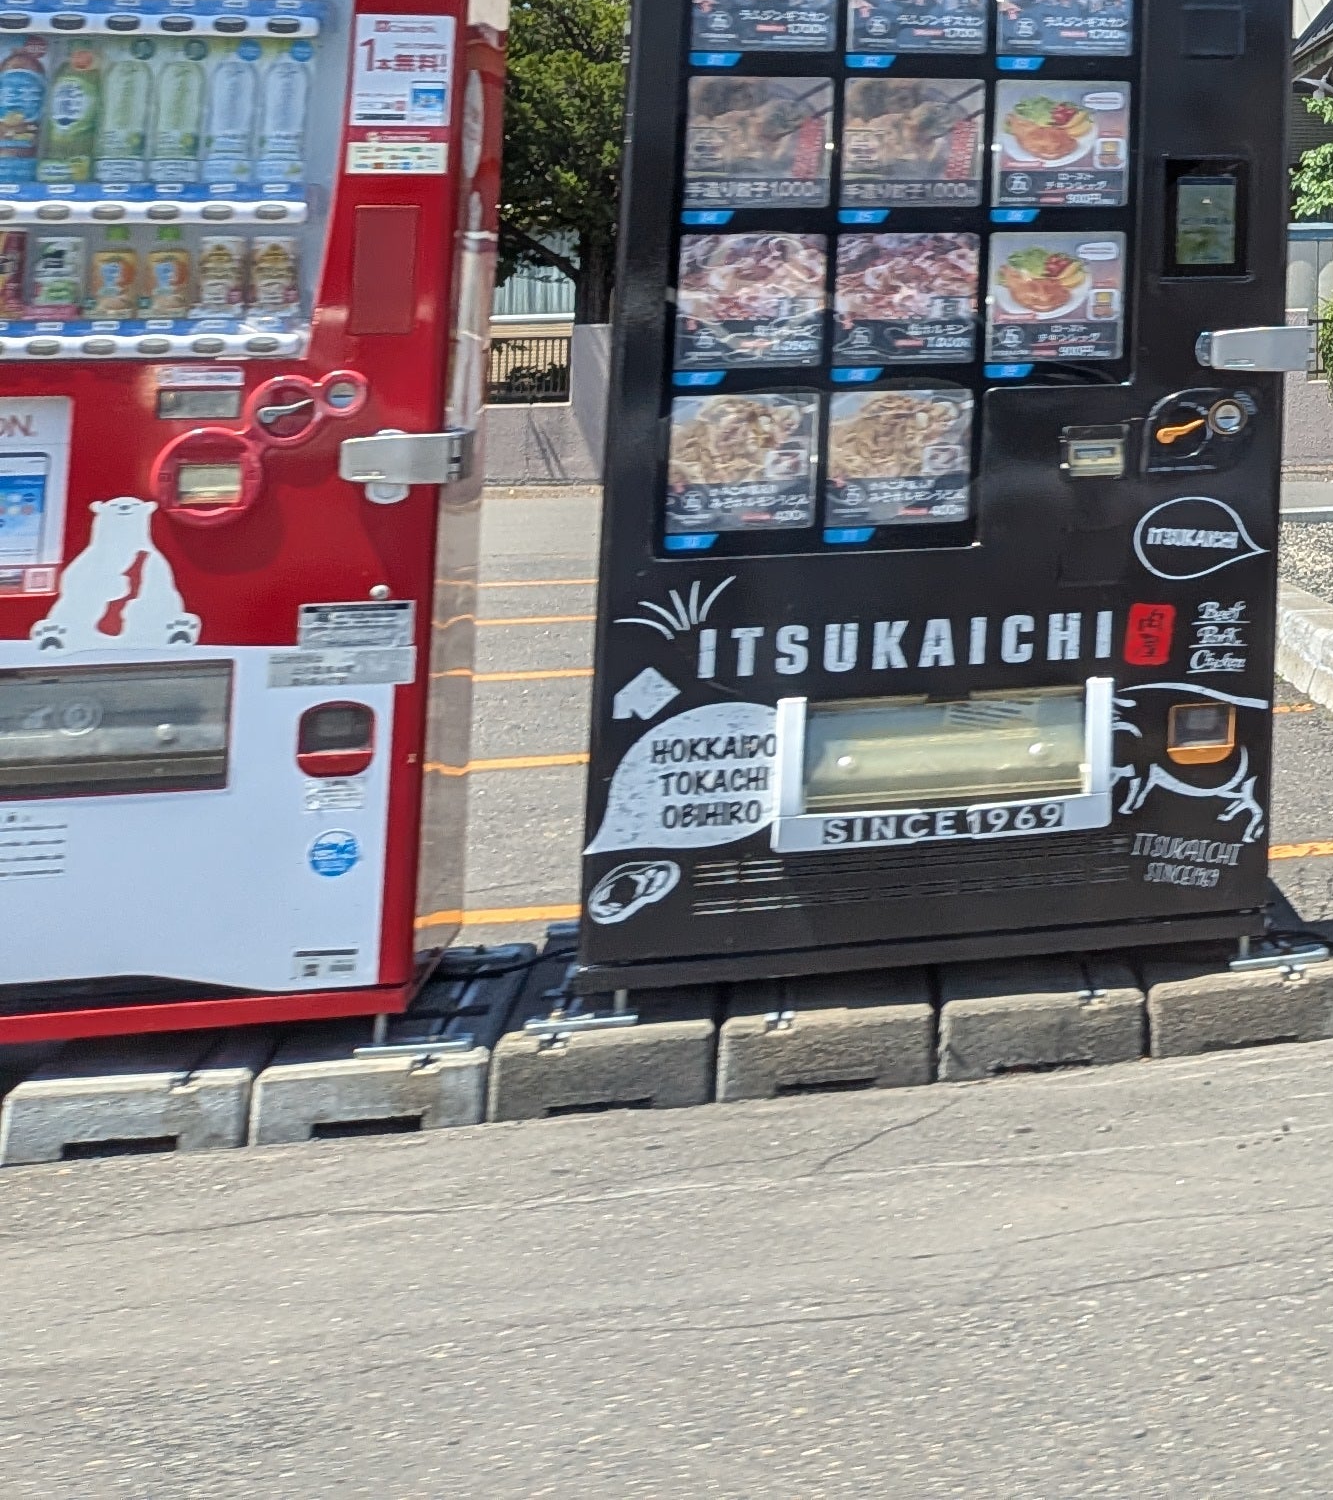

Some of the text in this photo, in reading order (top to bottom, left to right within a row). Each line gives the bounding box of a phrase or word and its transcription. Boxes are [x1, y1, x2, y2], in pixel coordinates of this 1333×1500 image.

[697, 610, 1113, 679] ITSUKAICHI
[651, 734, 777, 764] HOKKAIDO
[658, 766, 770, 797] TOKACHI
[662, 799, 762, 829] OBIHIRO
[823, 802, 1063, 846] SINCE 1969
